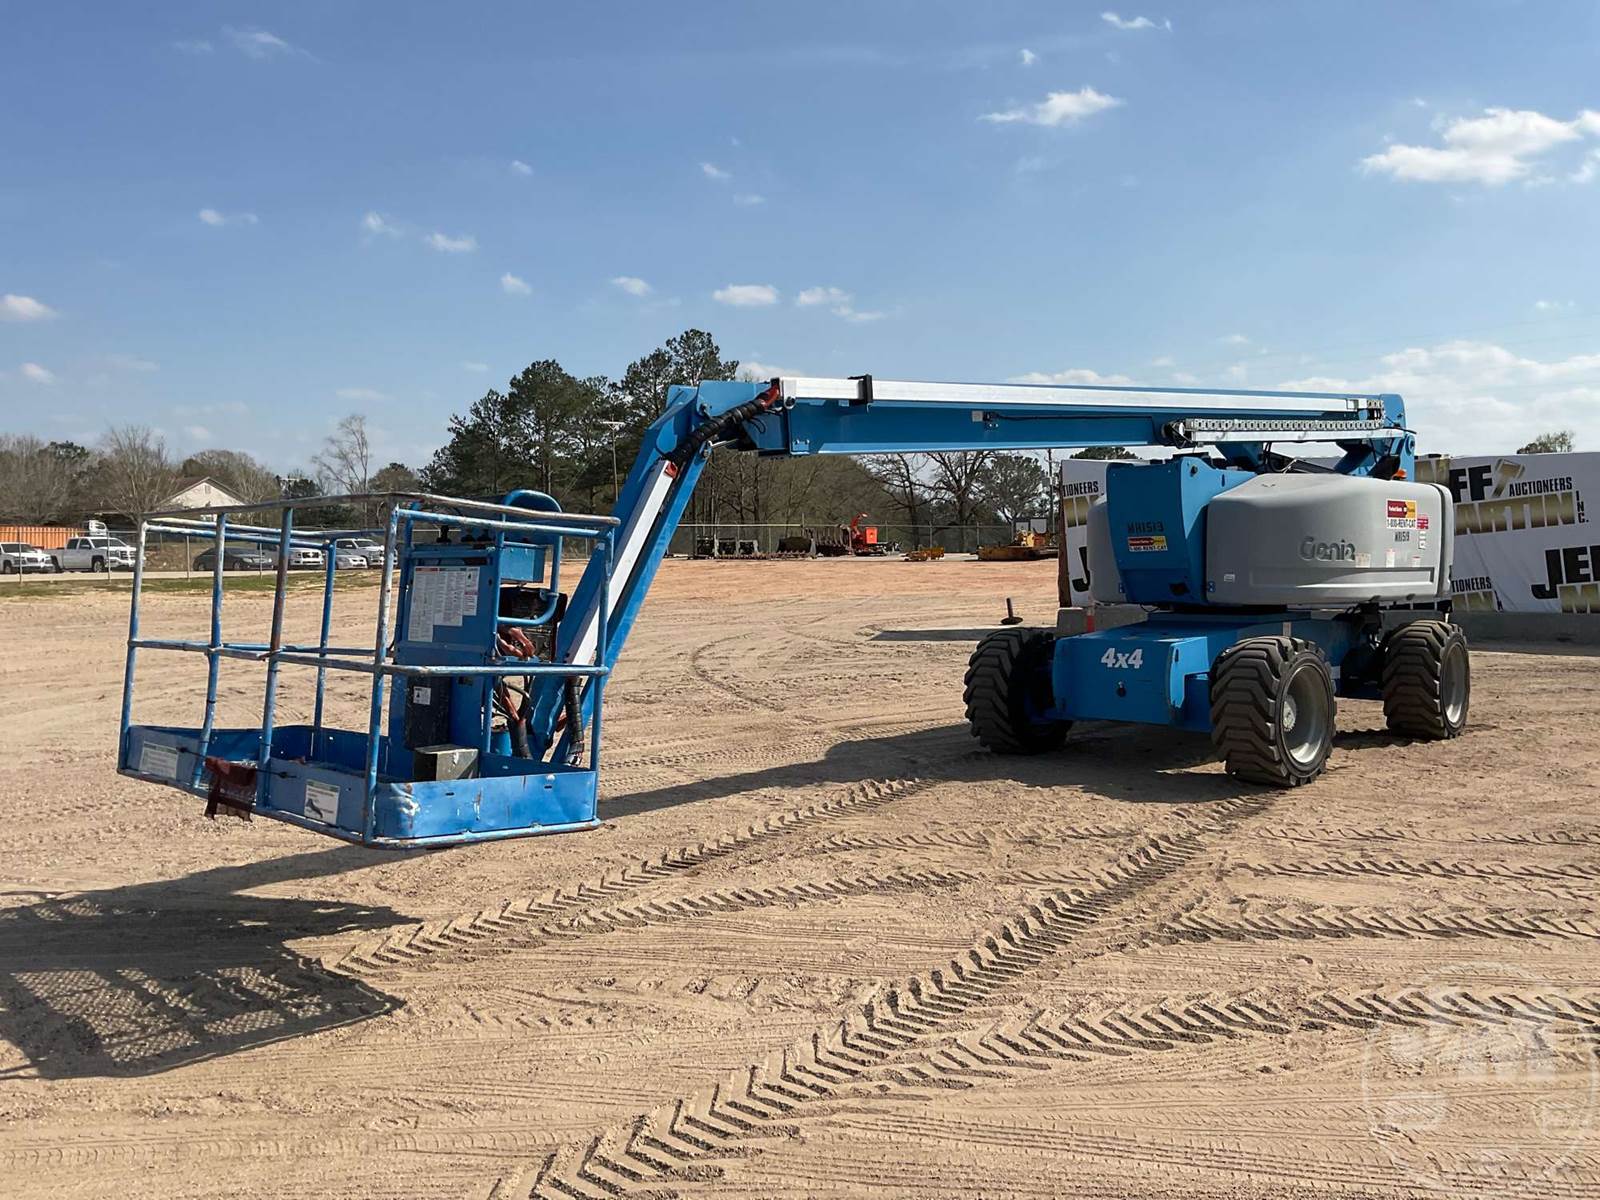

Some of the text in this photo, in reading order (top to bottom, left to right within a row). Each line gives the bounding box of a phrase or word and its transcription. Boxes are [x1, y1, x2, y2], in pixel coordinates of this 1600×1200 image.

[1062, 480, 1099, 498] TIONEERS
[1449, 465, 1493, 503] FF
[1508, 476, 1573, 497] AUCTIONEERS
[1454, 491, 1576, 537] ARTIN
[1450, 576, 1492, 593] TIONEERS
[1101, 647, 1144, 669] 4x4
